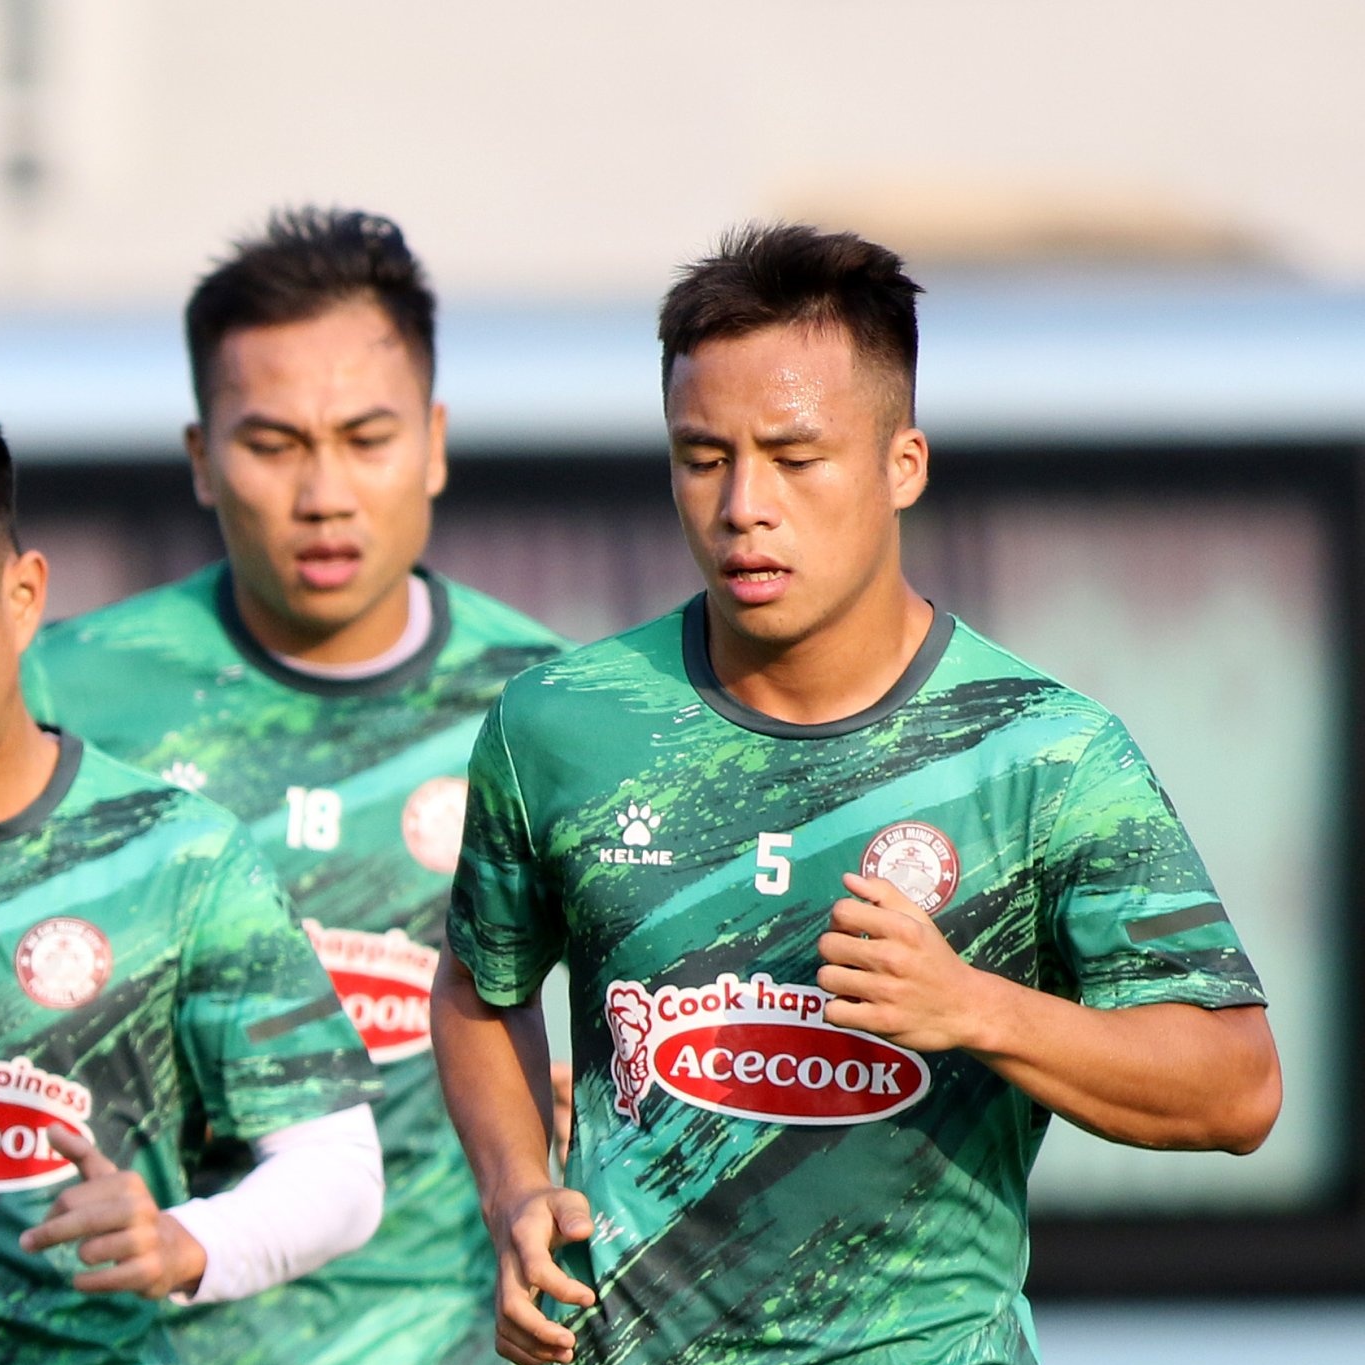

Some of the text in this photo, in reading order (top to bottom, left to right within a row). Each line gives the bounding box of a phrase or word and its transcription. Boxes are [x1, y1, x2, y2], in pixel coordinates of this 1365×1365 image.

[286, 786, 341, 851] 18
[600, 848, 673, 865] KELME
[754, 832, 793, 896] 5
[658, 982, 744, 1022] Cook
